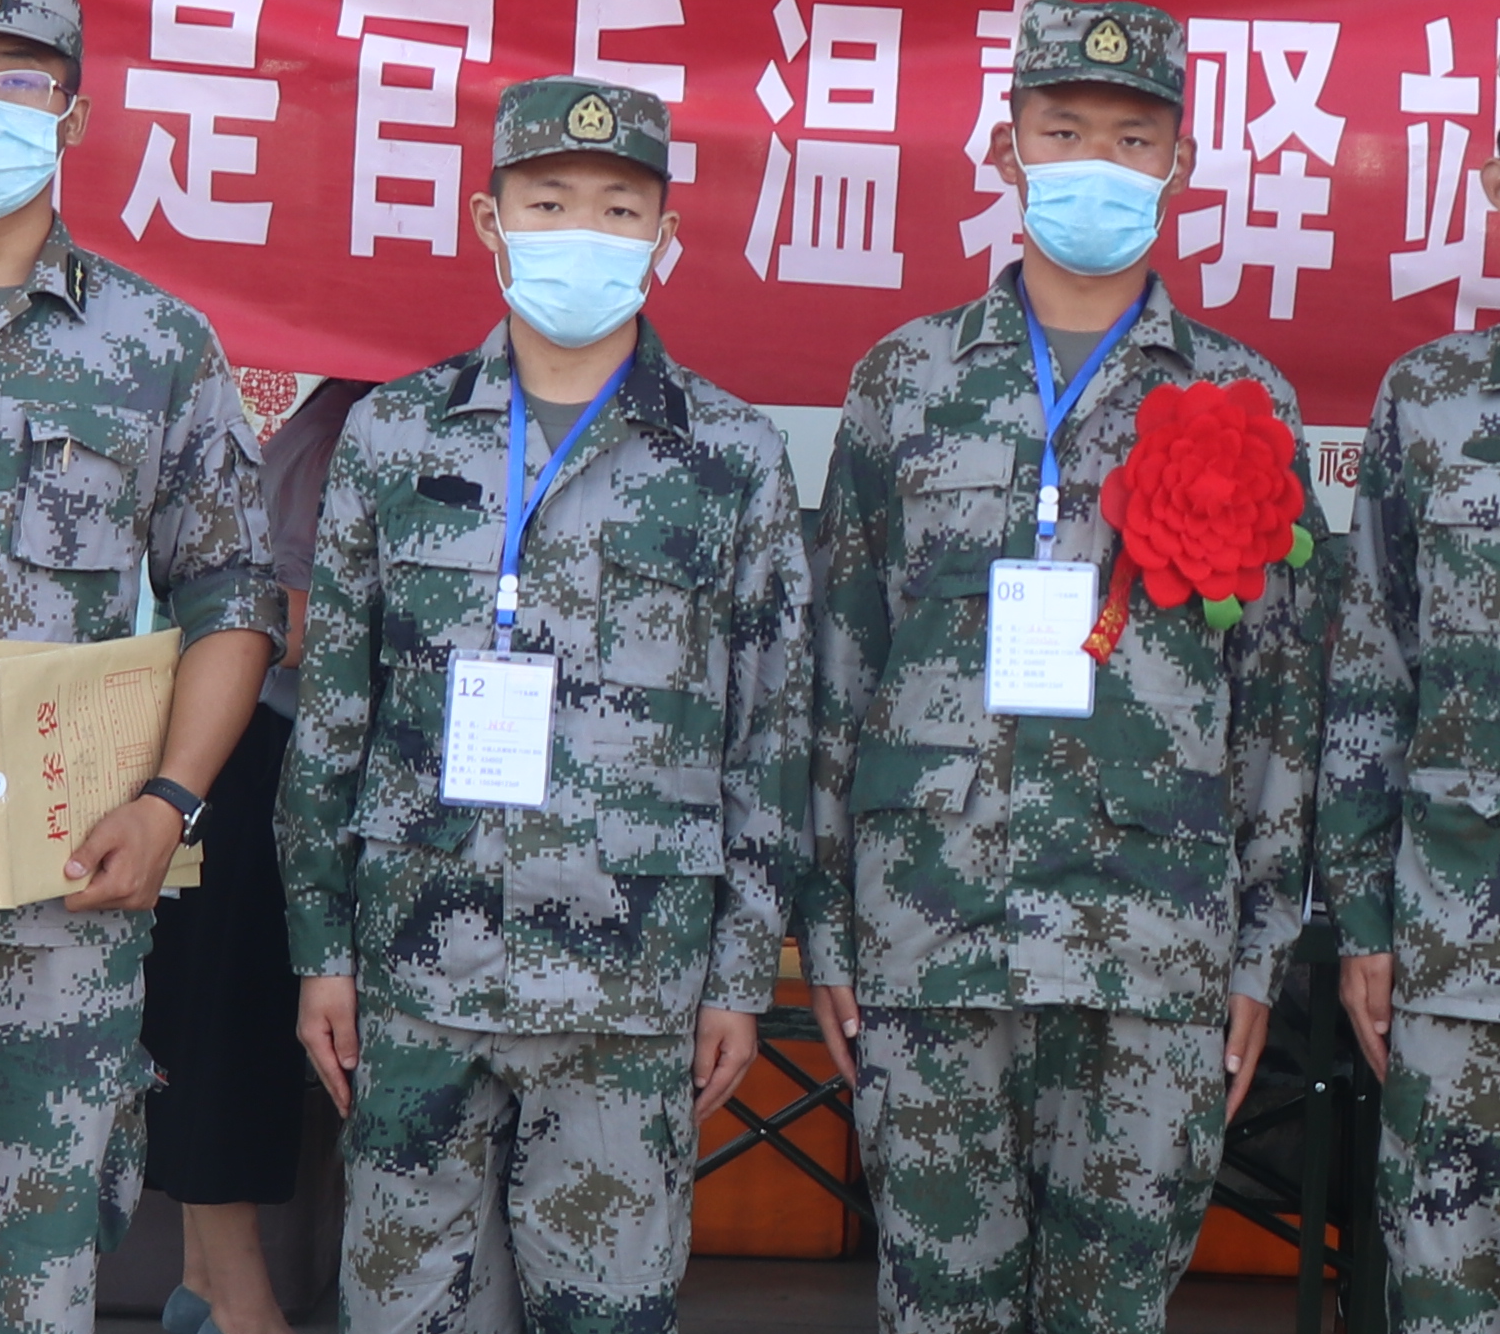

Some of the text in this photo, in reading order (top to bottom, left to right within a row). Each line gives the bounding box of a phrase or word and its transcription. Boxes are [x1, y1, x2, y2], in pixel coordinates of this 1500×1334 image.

[997, 581, 1026, 602] 08
[458, 677, 486, 698] 12
[37, 700, 70, 842] 档案袋
